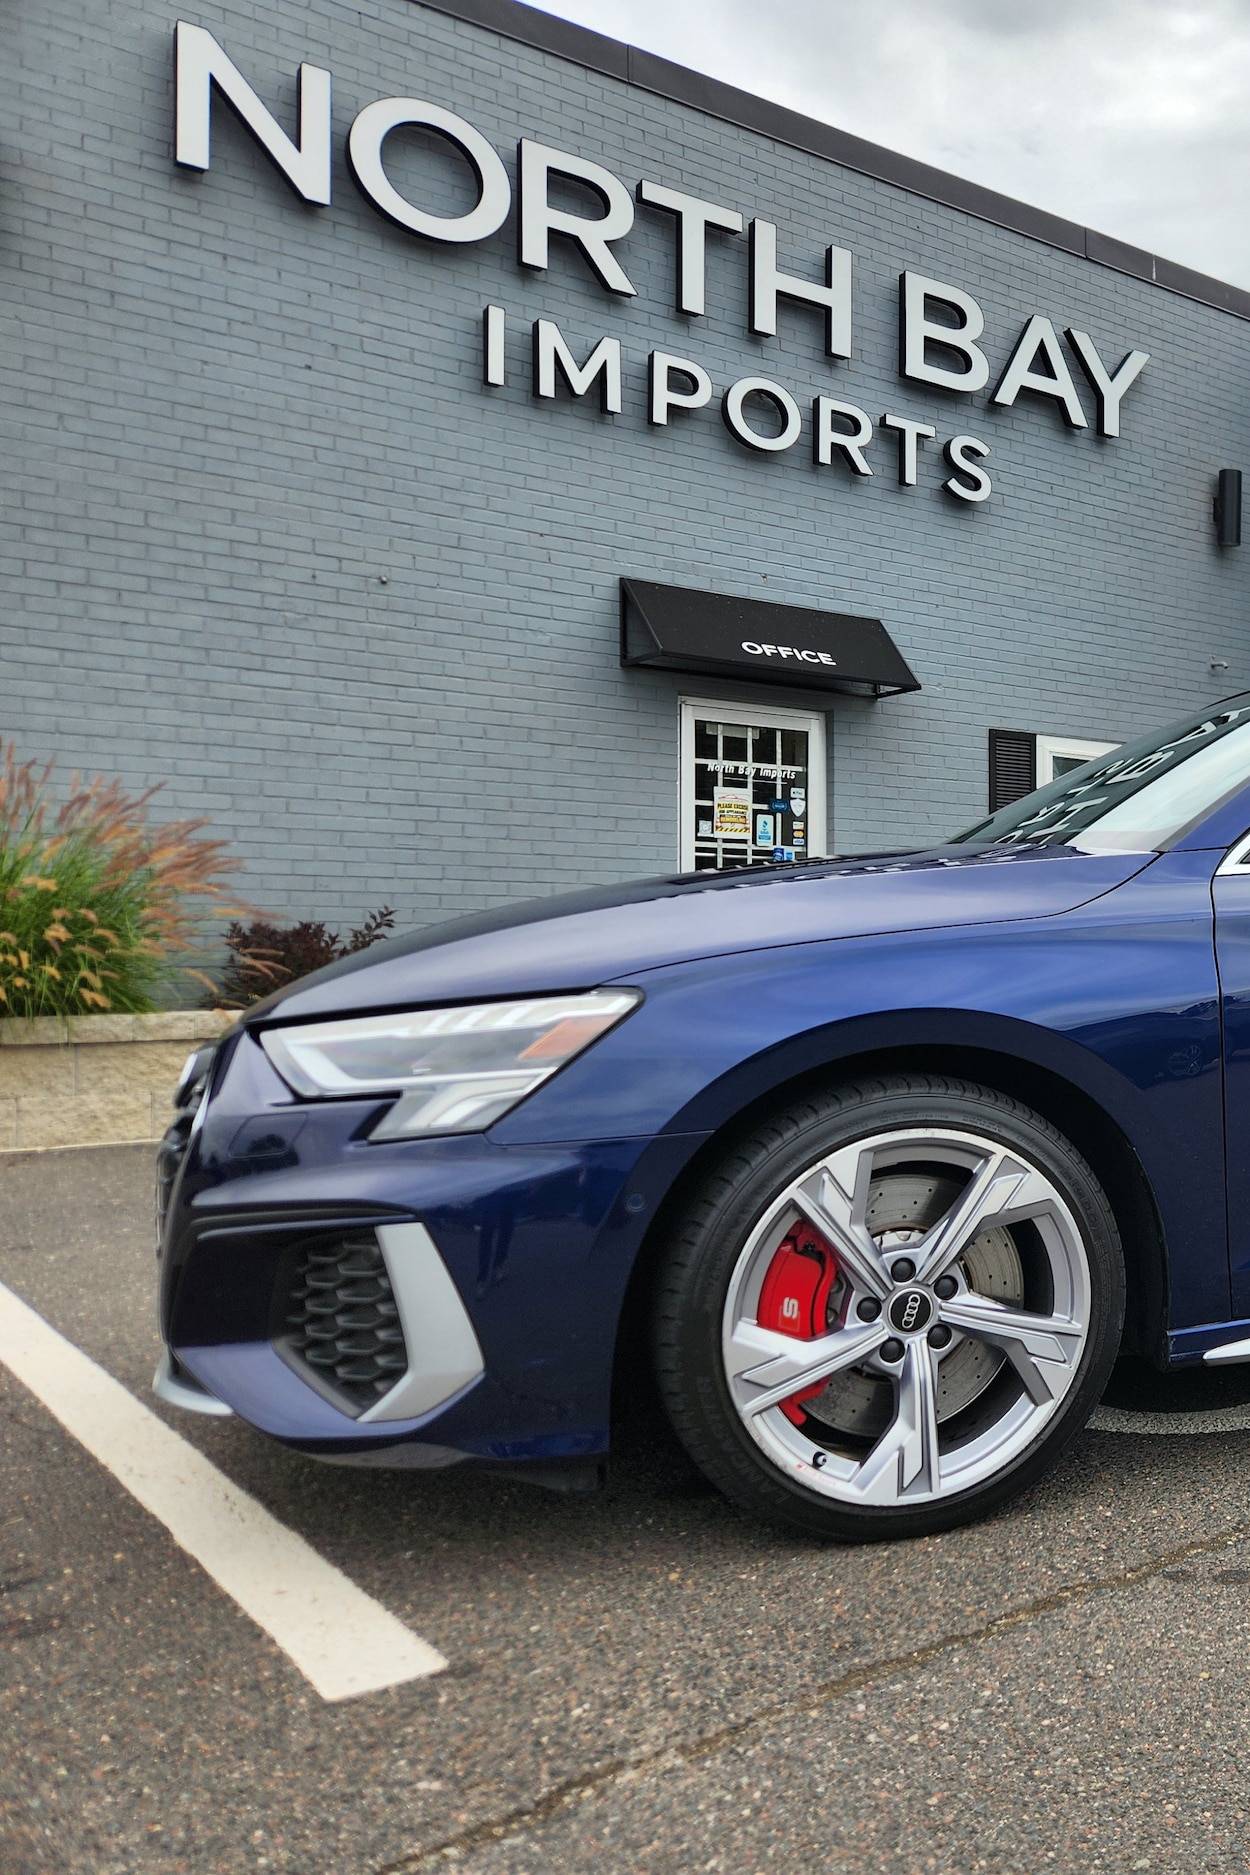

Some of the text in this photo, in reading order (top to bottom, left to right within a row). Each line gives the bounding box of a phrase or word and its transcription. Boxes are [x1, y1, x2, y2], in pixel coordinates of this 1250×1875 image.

[174, 18, 1152, 439] NORTH BAY
[482, 303, 993, 503] IMPORTS
[740, 641, 837, 666] OFFICE
[707, 763, 796, 779] North Bay Imports
[783, 1296, 798, 1319] S
